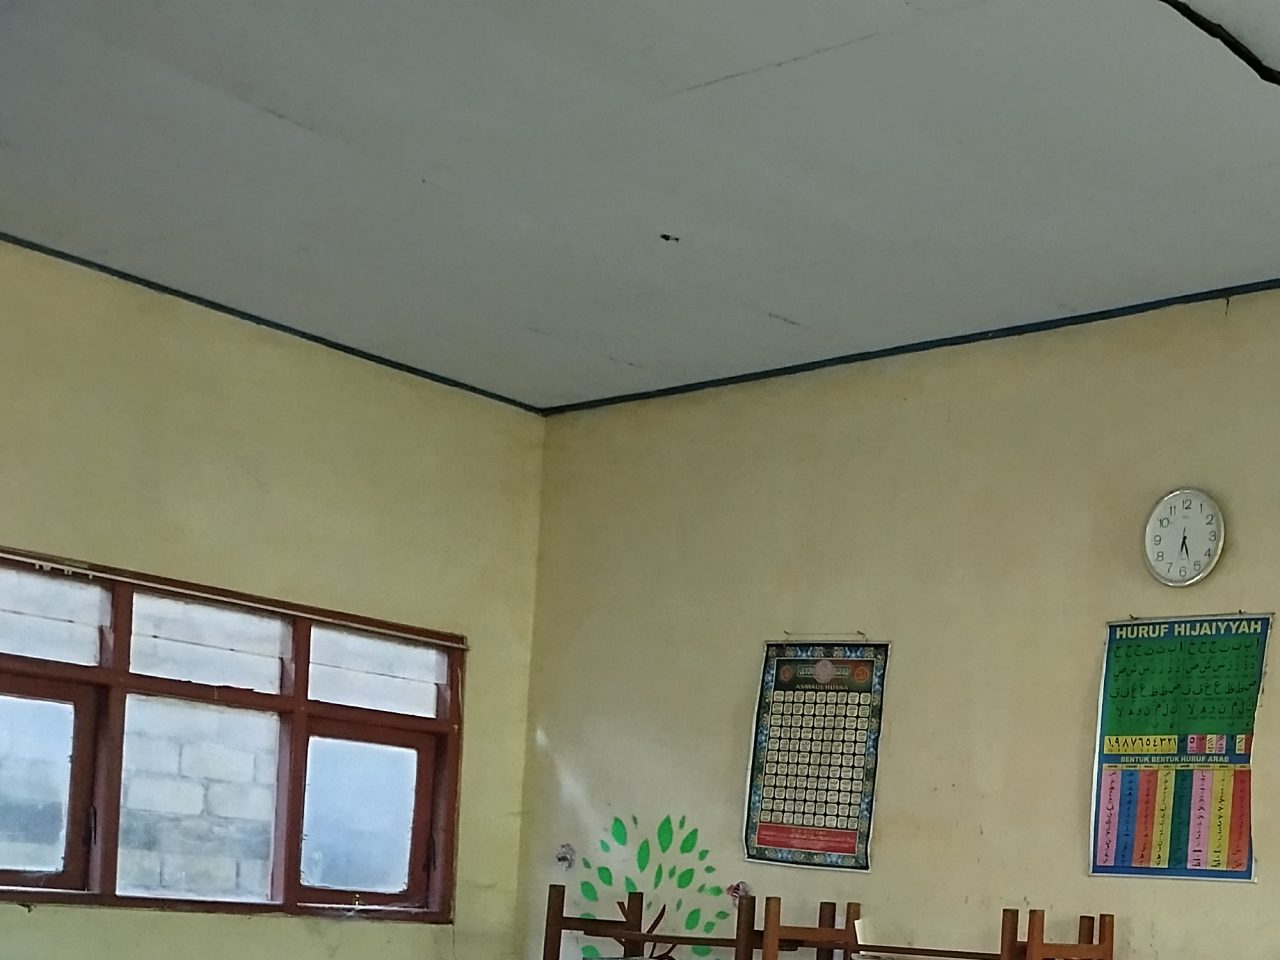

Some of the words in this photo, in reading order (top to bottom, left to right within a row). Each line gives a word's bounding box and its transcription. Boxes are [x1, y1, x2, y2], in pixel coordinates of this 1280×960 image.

[1169, 505, 1176, 515] 11
[1183, 499, 1192, 510] 12
[1159, 517, 1170, 528] 10
[1206, 514, 1214, 525] 2
[1154, 535, 1161, 545] 9
[1209, 531, 1216, 542] 3
[1157, 551, 1164, 562] 8
[1204, 548, 1211, 558] 4
[1167, 562, 1173, 573] 7
[1179, 566, 1187, 577] 6
[1193, 561, 1201, 571] 5
[1115, 624, 1169, 640] HURUF
[1174, 620, 1262, 637] HIJAIYYAH
[1120, 755, 1150, 763] BENTUK
[1151, 755, 1180, 763] BENTUK
[1180, 755, 1206, 763] HURUF
[1208, 755, 1230, 763] ARAB
